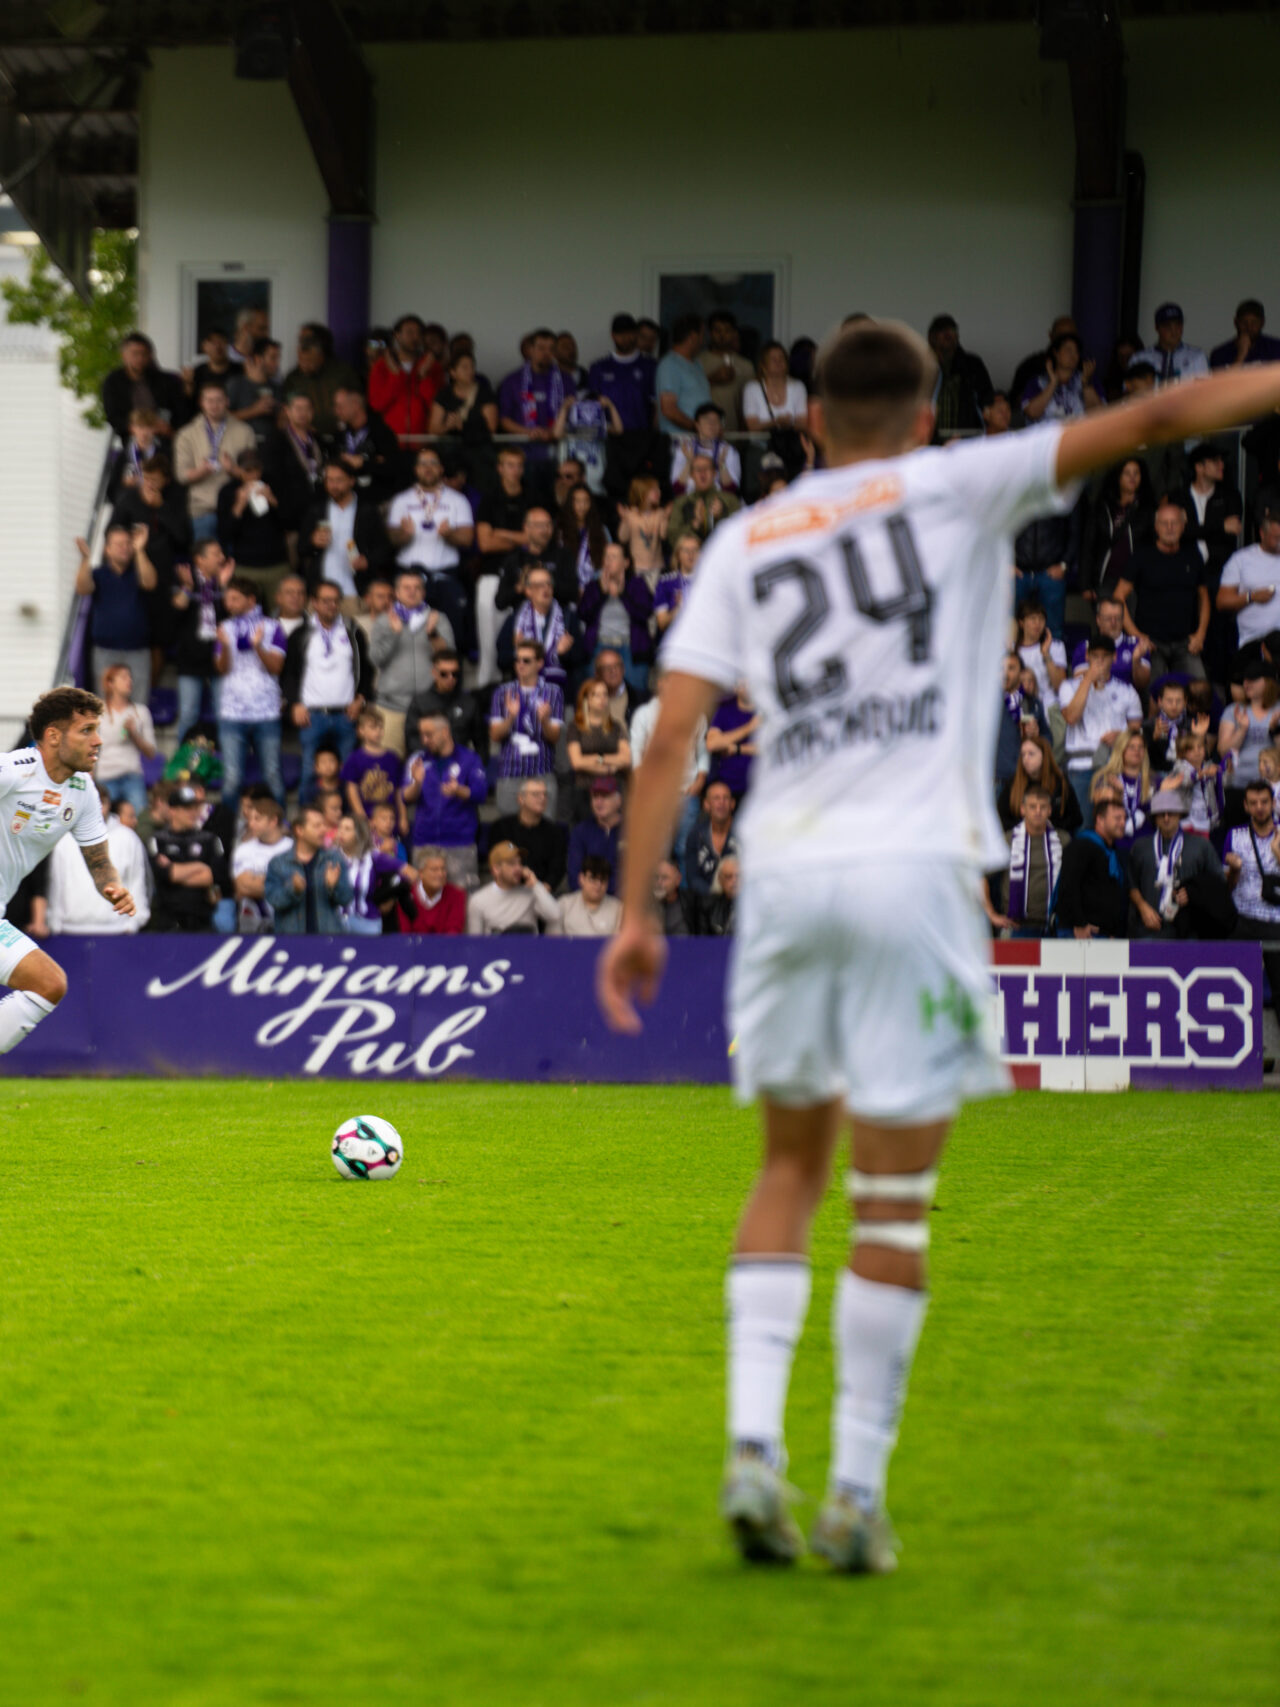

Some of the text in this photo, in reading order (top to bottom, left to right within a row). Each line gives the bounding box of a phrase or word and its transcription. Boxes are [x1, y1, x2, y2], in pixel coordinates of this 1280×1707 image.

[752, 508, 938, 708] 24
[268, 998, 487, 1075] Pub
[984, 966, 1253, 1067] HERS
